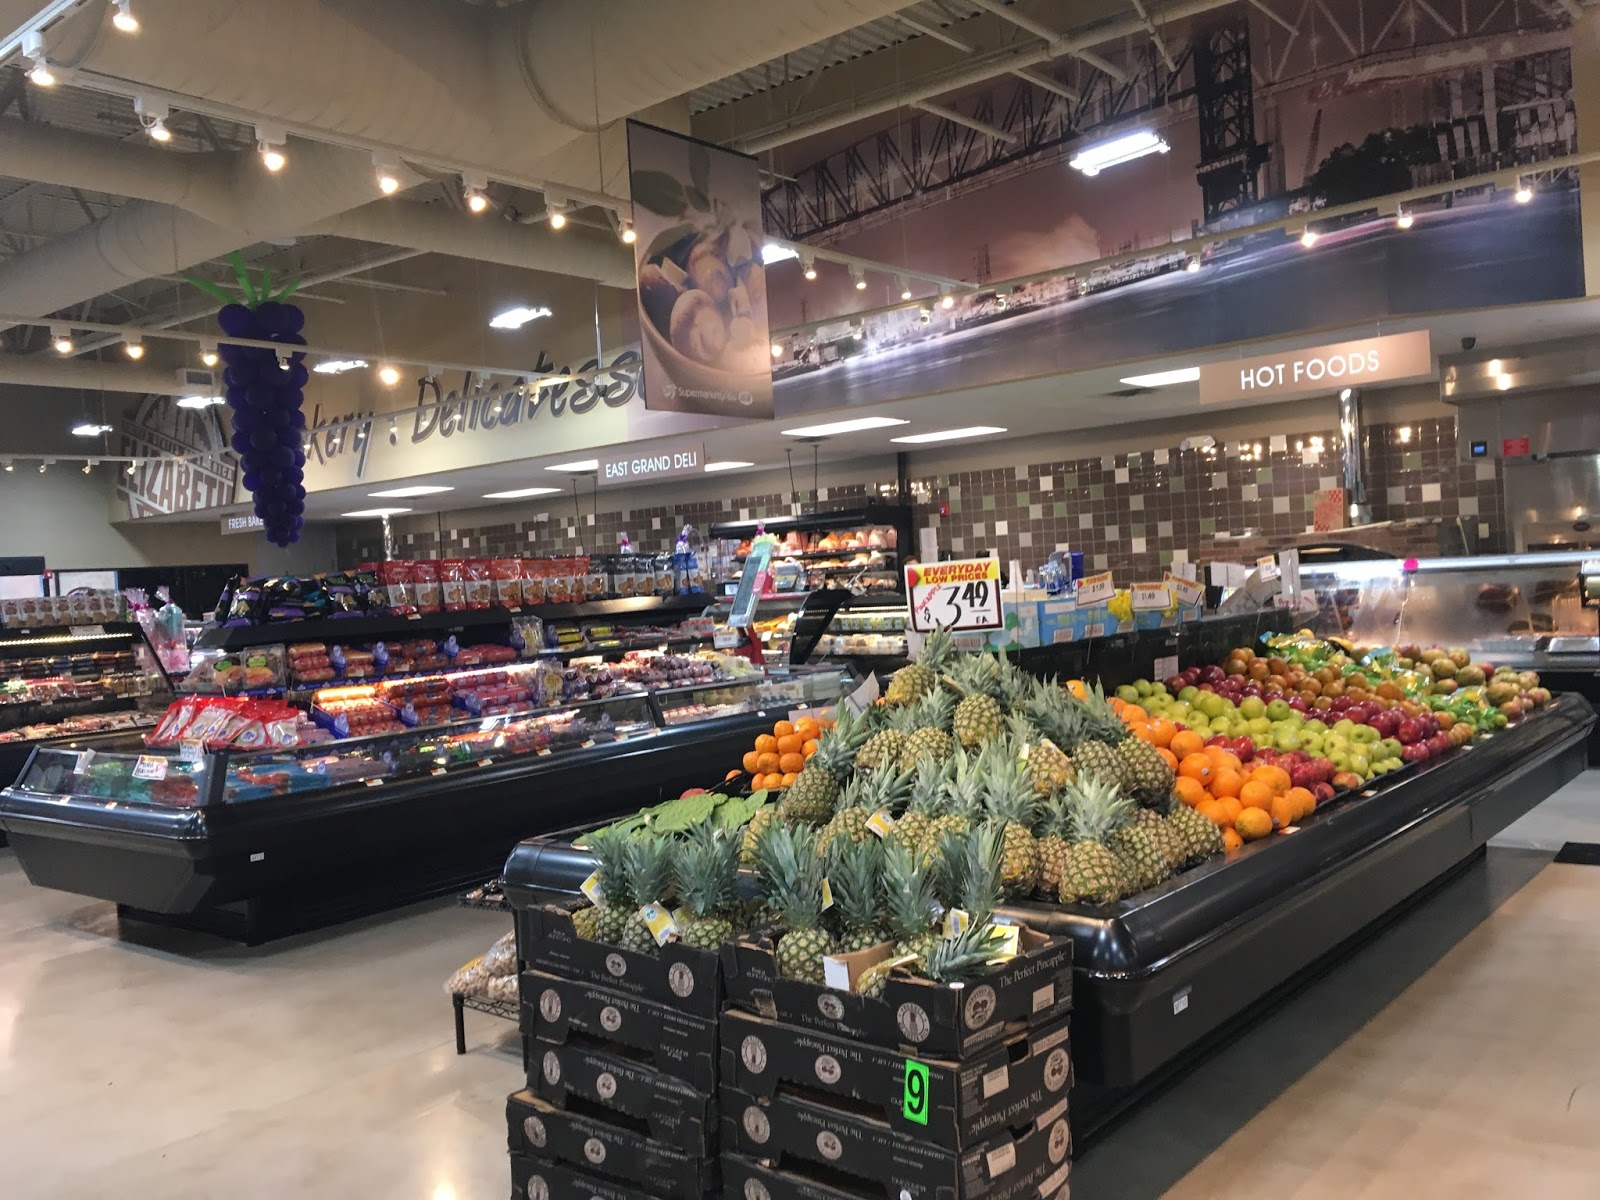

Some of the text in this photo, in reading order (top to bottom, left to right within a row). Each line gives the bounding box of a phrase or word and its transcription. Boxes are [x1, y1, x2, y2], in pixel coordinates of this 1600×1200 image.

[1240, 350, 1380, 390] HOT FOODS
[304, 403, 375, 478] kery
[411, 350, 645, 444] Delicatess
[605, 451, 697, 478] EAST GRAND DELI
[228, 515, 264, 530] FRESH BAKE
[923, 561, 992, 577] EVERYDAY
[925, 572, 988, 584] LOW PRICES
[590, 971, 601, 981] The
[999, 951, 1067, 988] The Perfect Pineapple
[629, 1003, 641, 1015] The
[801, 1014, 813, 1024] The
[794, 1037, 863, 1063] The Perfect Pineapple
[907, 1069, 925, 1114] 9
[1031, 1089, 1043, 1101] The
[1008, 1096, 1030, 1115] Perfect
[850, 1129, 863, 1141] The
